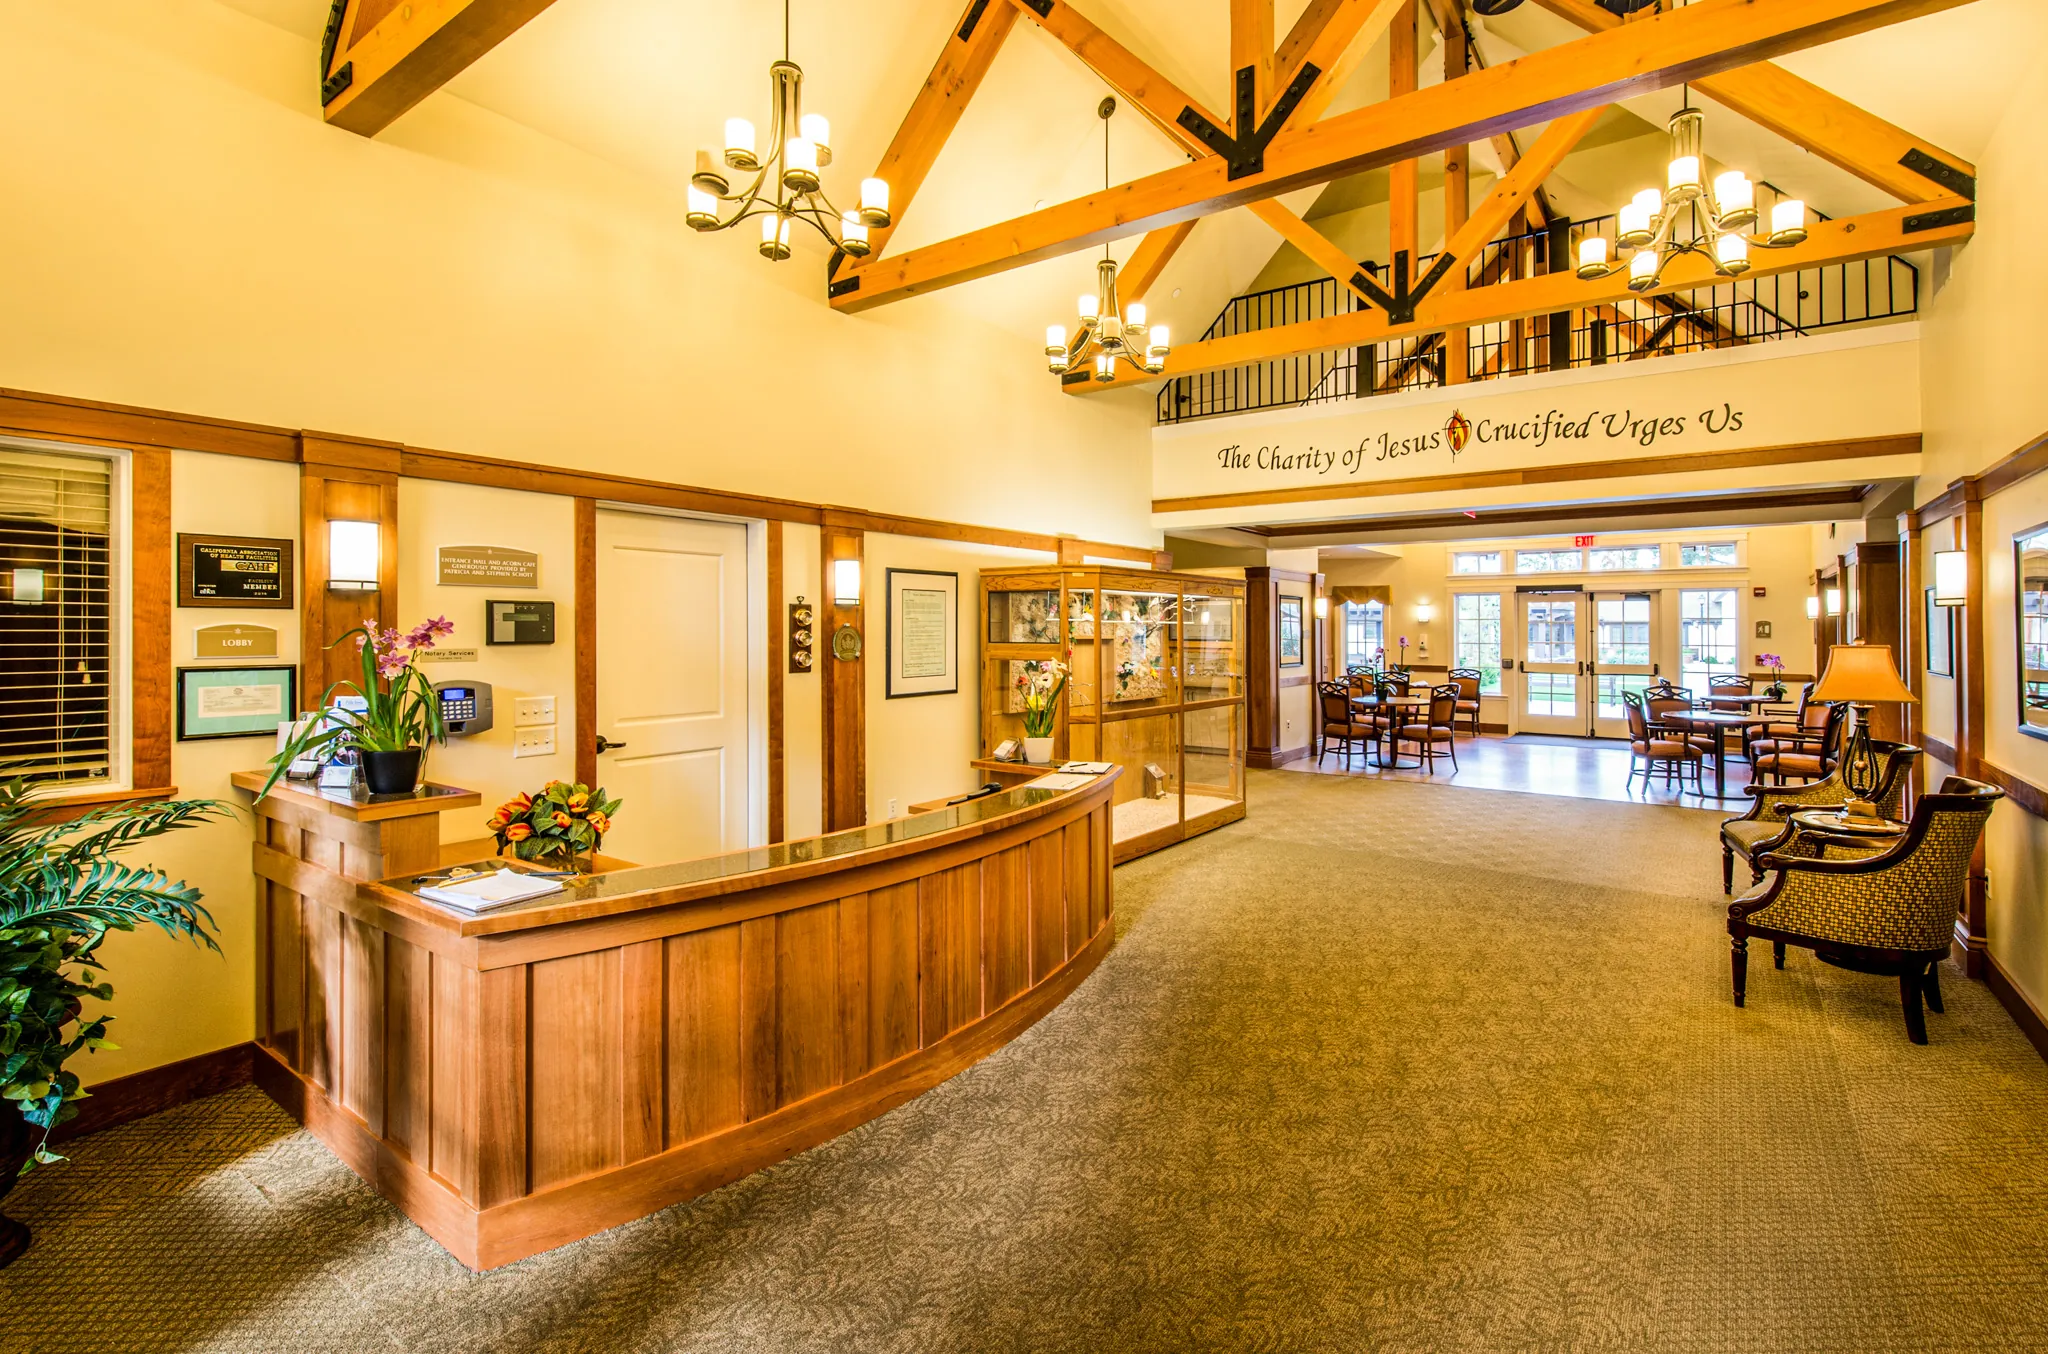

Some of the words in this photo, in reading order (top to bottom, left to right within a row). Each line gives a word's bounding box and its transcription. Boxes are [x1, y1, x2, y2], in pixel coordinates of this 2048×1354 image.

[1217, 444, 1251, 469] The
[1257, 445, 1336, 475] Charity
[1342, 437, 1371, 475] of
[1376, 431, 1441, 462] Jesus
[1476, 408, 1600, 448] Crucified
[1601, 409, 1687, 447] Urges
[1698, 402, 1744, 434] Us
[1575, 535, 1595, 548] EXIT
[235, 562, 275, 572] CAHF
[243, 583, 278, 591] MEMBER
[222, 639, 254, 647] LOBBY
